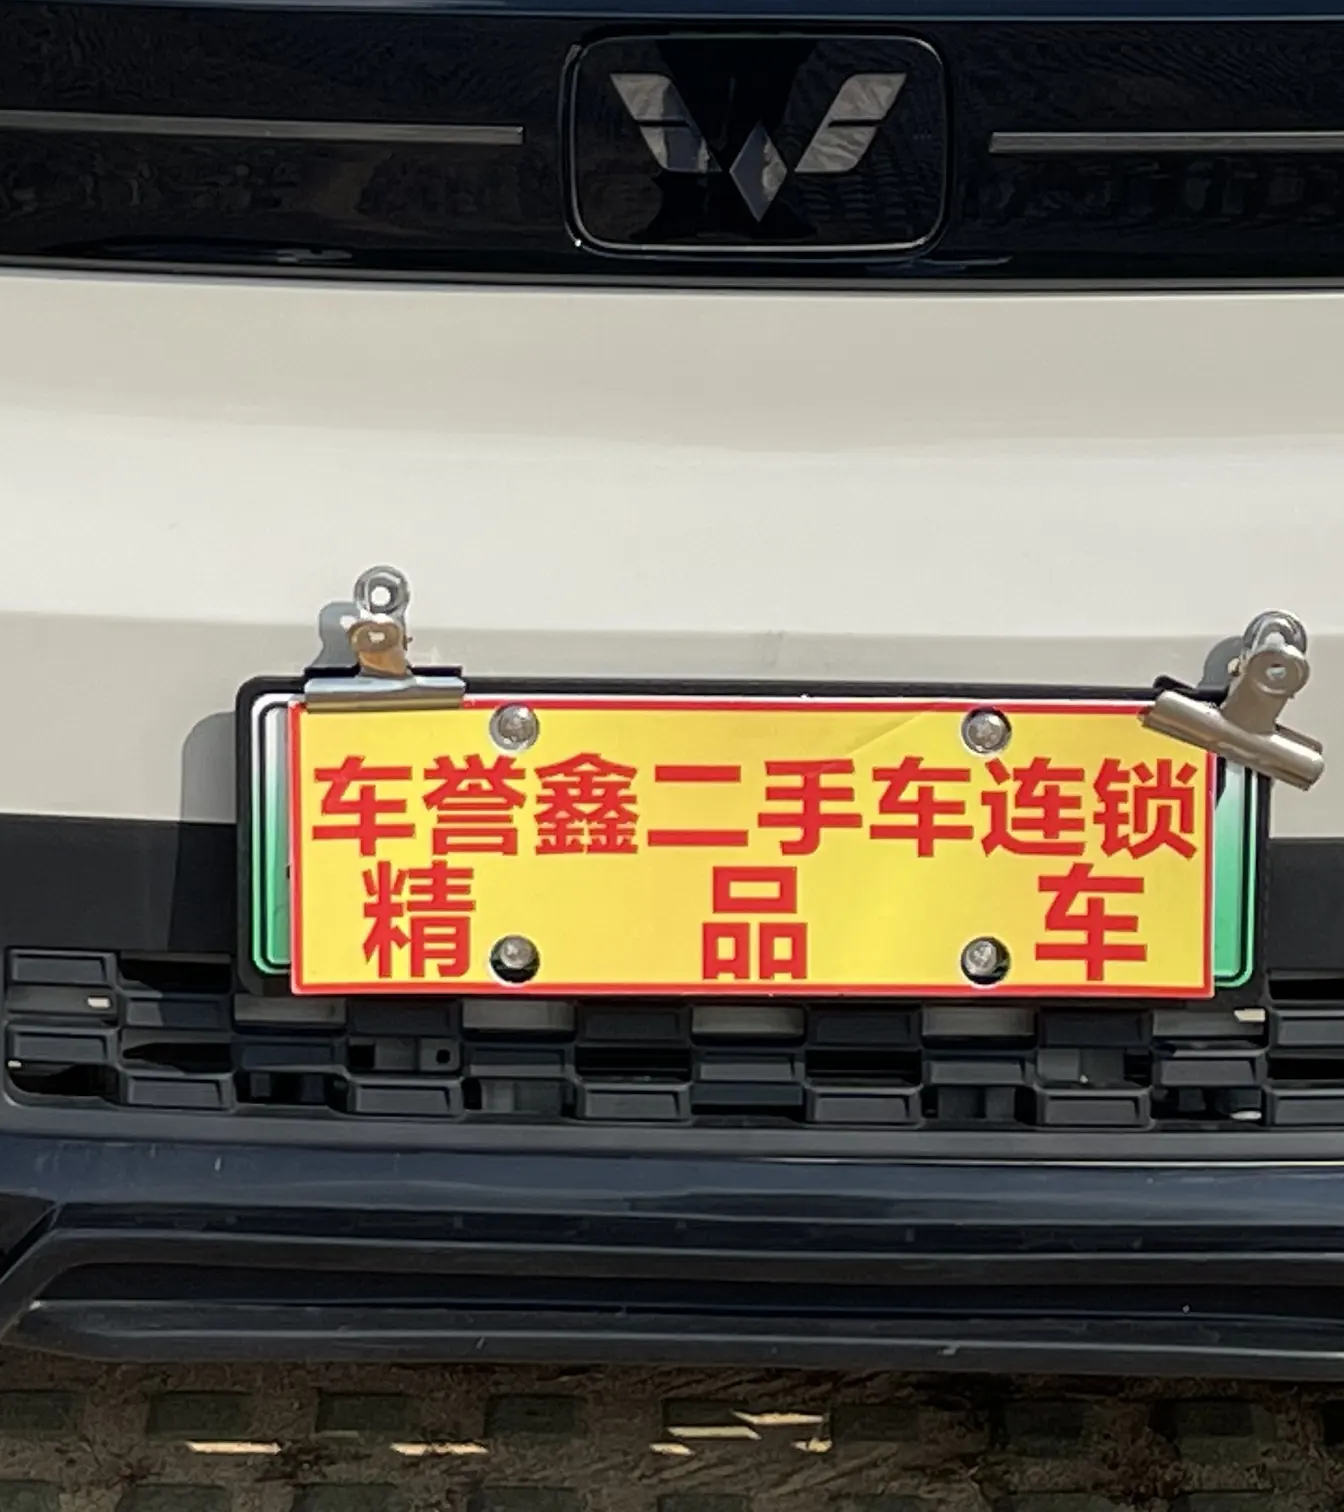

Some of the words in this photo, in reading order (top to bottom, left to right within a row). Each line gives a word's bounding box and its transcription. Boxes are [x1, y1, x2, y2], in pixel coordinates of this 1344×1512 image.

[311, 751, 1199, 860] 车誉鑫二手车连锁
[361, 858, 476, 979] 精
[700, 865, 808, 981] 品
[1034, 861, 1148, 982] 车
